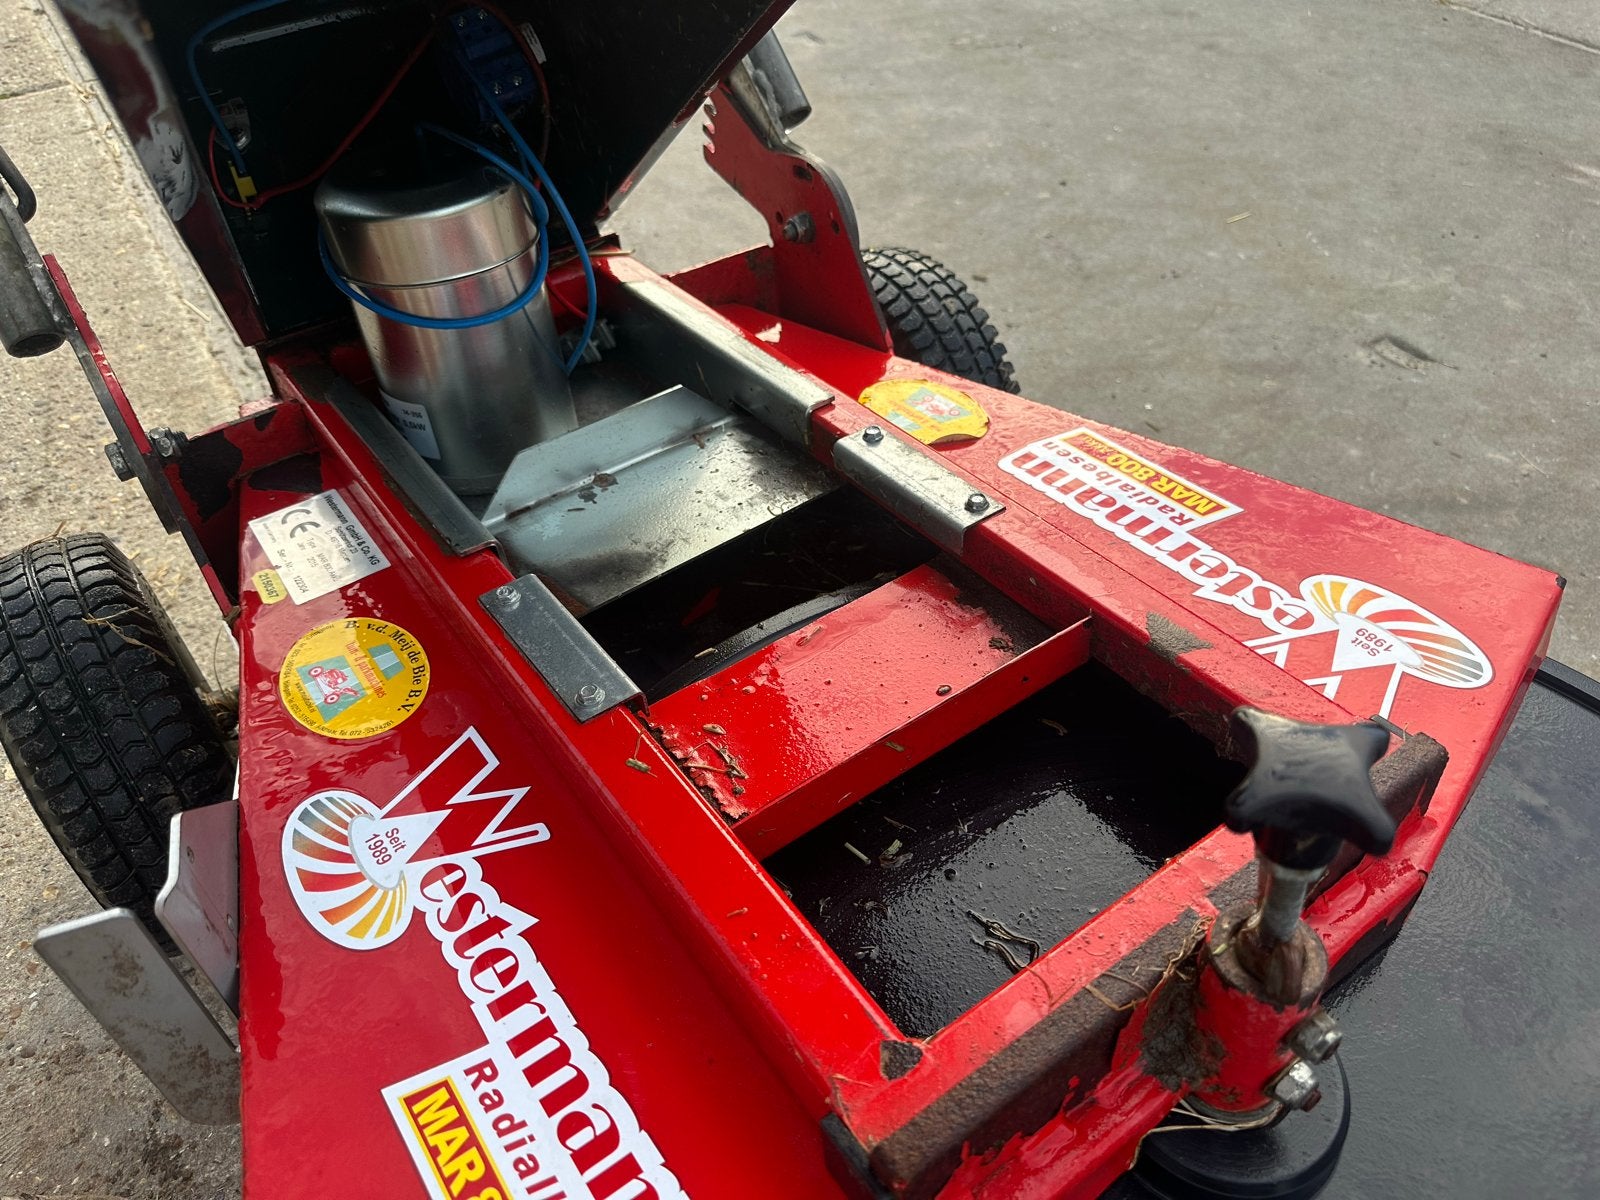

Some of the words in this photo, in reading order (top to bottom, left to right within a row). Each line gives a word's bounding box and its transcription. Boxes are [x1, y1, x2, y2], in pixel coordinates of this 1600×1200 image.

[1106, 454, 1155, 481] 800
[1041, 440, 1195, 527] Radialbesen
[1150, 473, 1218, 514] MAR
[324, 494, 348, 524] Westermann
[346, 524, 363, 541] GmbH
[360, 545, 371, 557] Co.
[367, 554, 380, 566] KG
[258, 572, 280, 599] 2150367
[344, 620, 360, 629] B.
[366, 623, 388, 634] v.d.
[388, 629, 415, 652] Meij
[1350, 636, 1381, 658] Seit
[1355, 627, 1394, 653] 1989
[407, 650, 421, 664] de
[412, 664, 426, 686] Bie
[397, 688, 423, 713] B.V.
[365, 833, 392, 866] 1989
[385, 827, 407, 853] Seit
[411, 1086, 486, 1198] MAR
